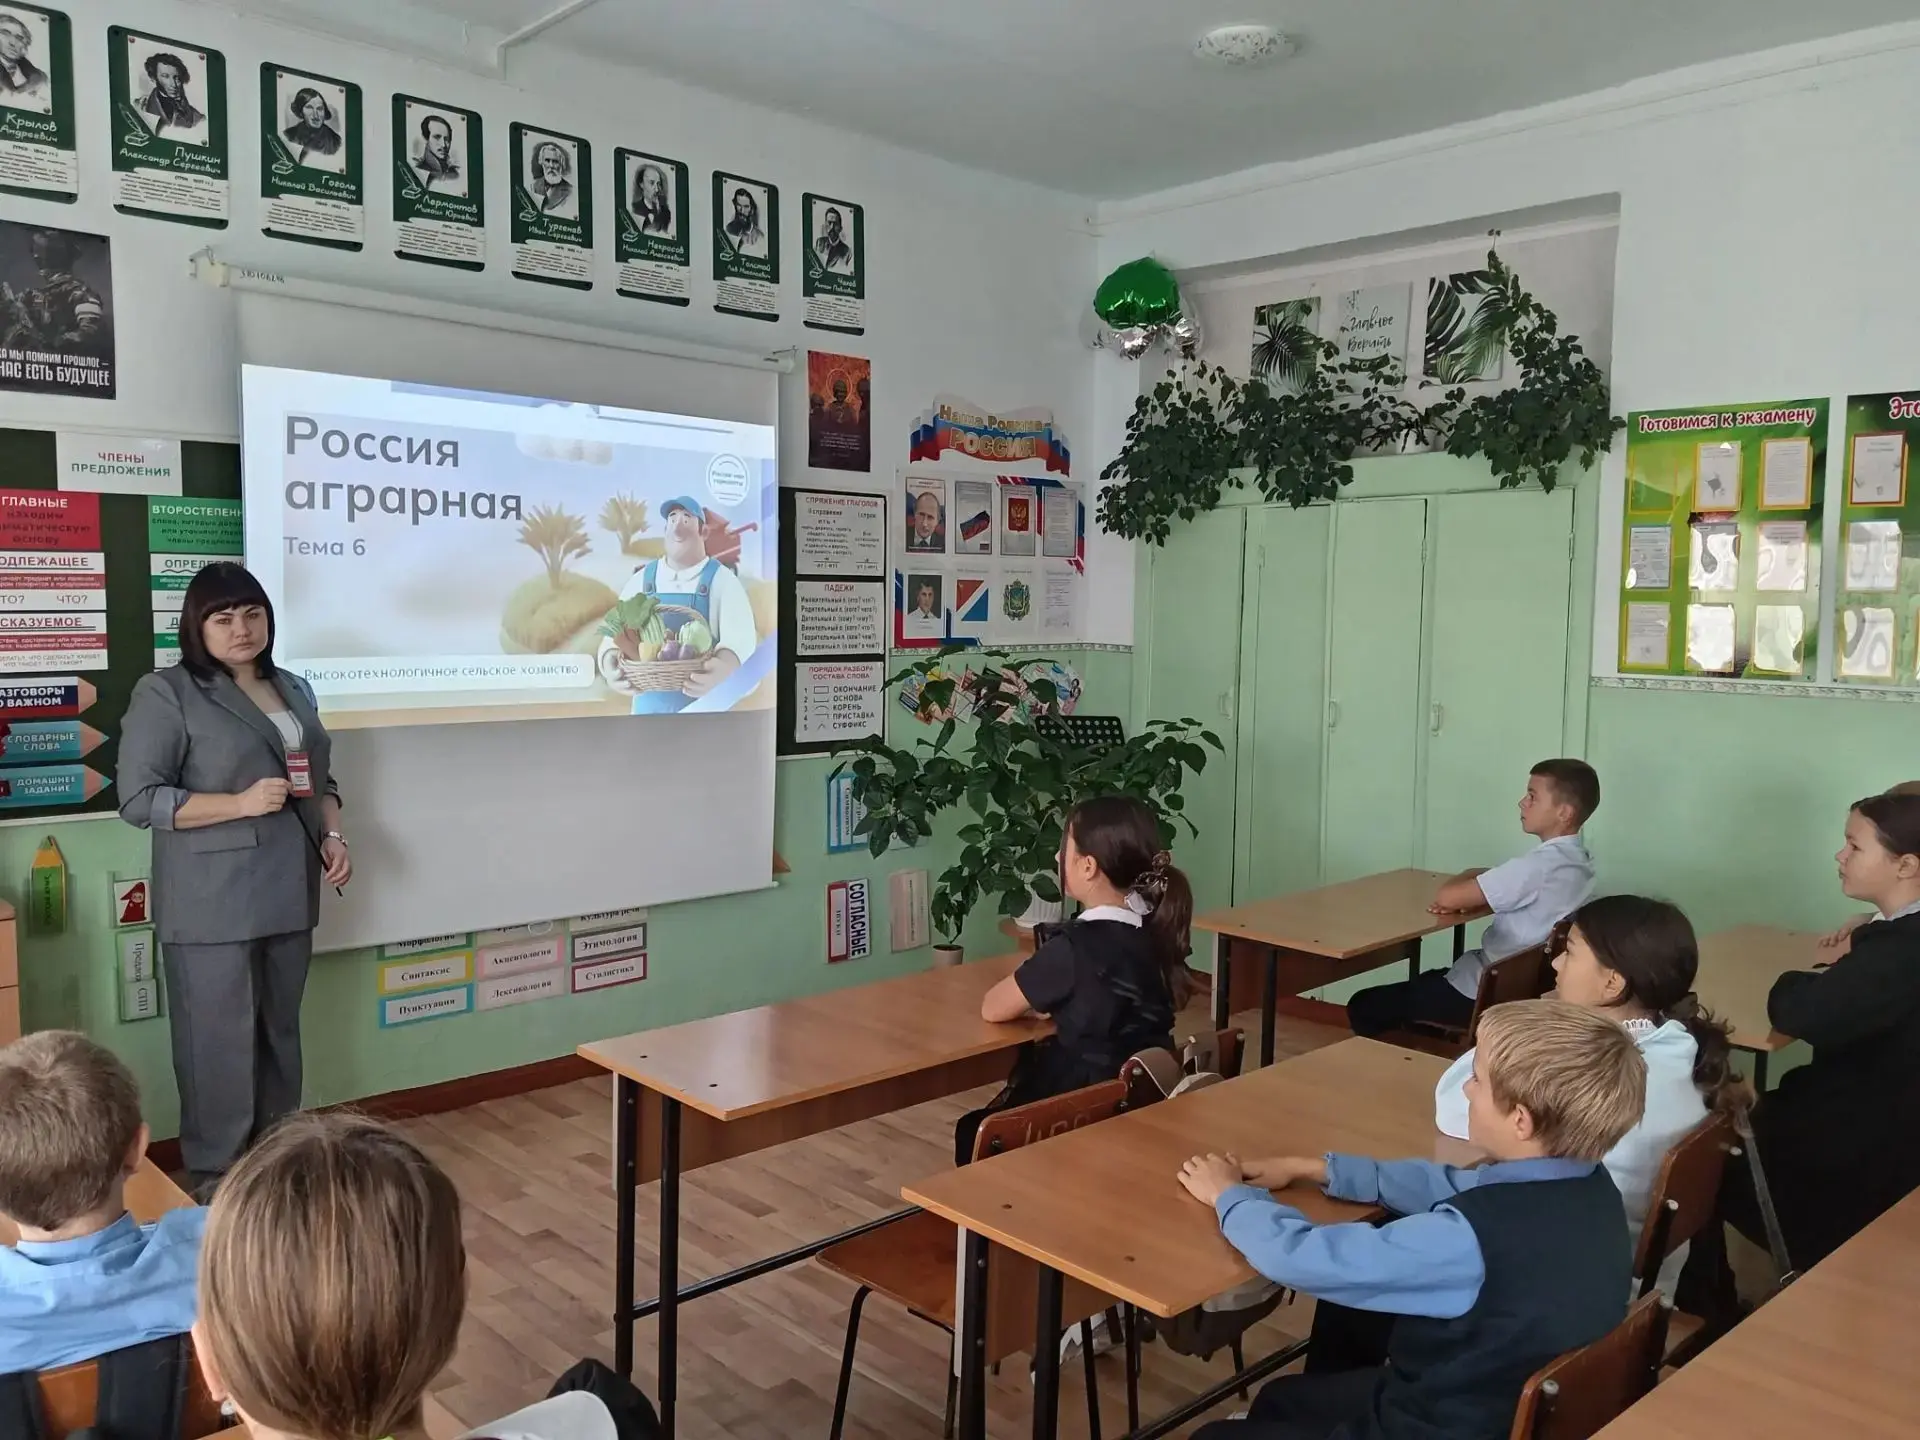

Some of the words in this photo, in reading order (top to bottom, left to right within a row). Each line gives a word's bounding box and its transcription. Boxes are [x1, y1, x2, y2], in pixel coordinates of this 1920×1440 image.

[6, 112, 57, 132] Крылов
[0, 124, 58, 142] Андреевич
[120, 148, 170, 167] Александр
[173, 158, 221, 174] Сергеевич
[175, 146, 221, 164] Пушкин
[271, 176, 305, 190] Николай
[321, 175, 356, 191] Гоголь
[422, 194, 478, 213] Лермонтов
[543, 218, 582, 235] Тургенев
[741, 258, 771, 271] Толстой
[1350, 306, 1394, 331] Главное
[9, 349, 24, 360] МЫ
[26, 351, 61, 364] ПОМНИМ
[63, 355, 100, 368] ПРОШЛОЕ
[25, 363, 53, 381] ЕСТЬ
[56, 366, 110, 387] БУДУЩЕЕ
[940, 404, 984, 426] Наша
[987, 416, 1043, 434] Родина
[1639, 415, 1716, 433] Готовимся
[1721, 414, 1734, 428] к
[1736, 407, 1816, 428] экзамену
[286, 415, 459, 467] Россия
[98, 452, 145, 464] ЧЛЕНЫ
[71, 463, 170, 477] ПРЕДЛОЖЕНИЯ
[2, 496, 68, 508] ГЛАВНЫЕ
[285, 480, 522, 525] аграрная
[283, 536, 344, 556] Тема
[352, 538, 366, 556] 6
[824, 584, 856, 592] ПАДЕЖИ
[56, 595, 88, 604] ЧТО?
[0, 617, 82, 627] СКАЗУЕМОЕ
[304, 666, 459, 681] Высокотехнологичное
[462, 665, 516, 677] сельское
[833, 685, 877, 693] ОКОНЧАНИЕ
[7, 697, 62, 707] ВАЖНОМ
[833, 694, 863, 702] ОСНОВА
[833, 712, 875, 720] ПРИСТАВКА
[833, 721, 867, 729] СУФФИКС
[8, 732, 76, 743] СЛОВАРНЫЕ
[23, 743, 60, 751] СЛОВА
[17, 776, 76, 786] ДОМАШНЕЕ
[24, 785, 71, 794] ЗАДАНИЕ
[849, 883, 866, 956] СОГЛАСНЫЕ
[581, 933, 638, 951] Этимология
[492, 949, 551, 965] Акцентология
[401, 967, 451, 981] Синтаксис
[585, 966, 634, 981] Стилистика
[492, 980, 552, 998] Лексикология
[399, 999, 455, 1015] Пунктуация
